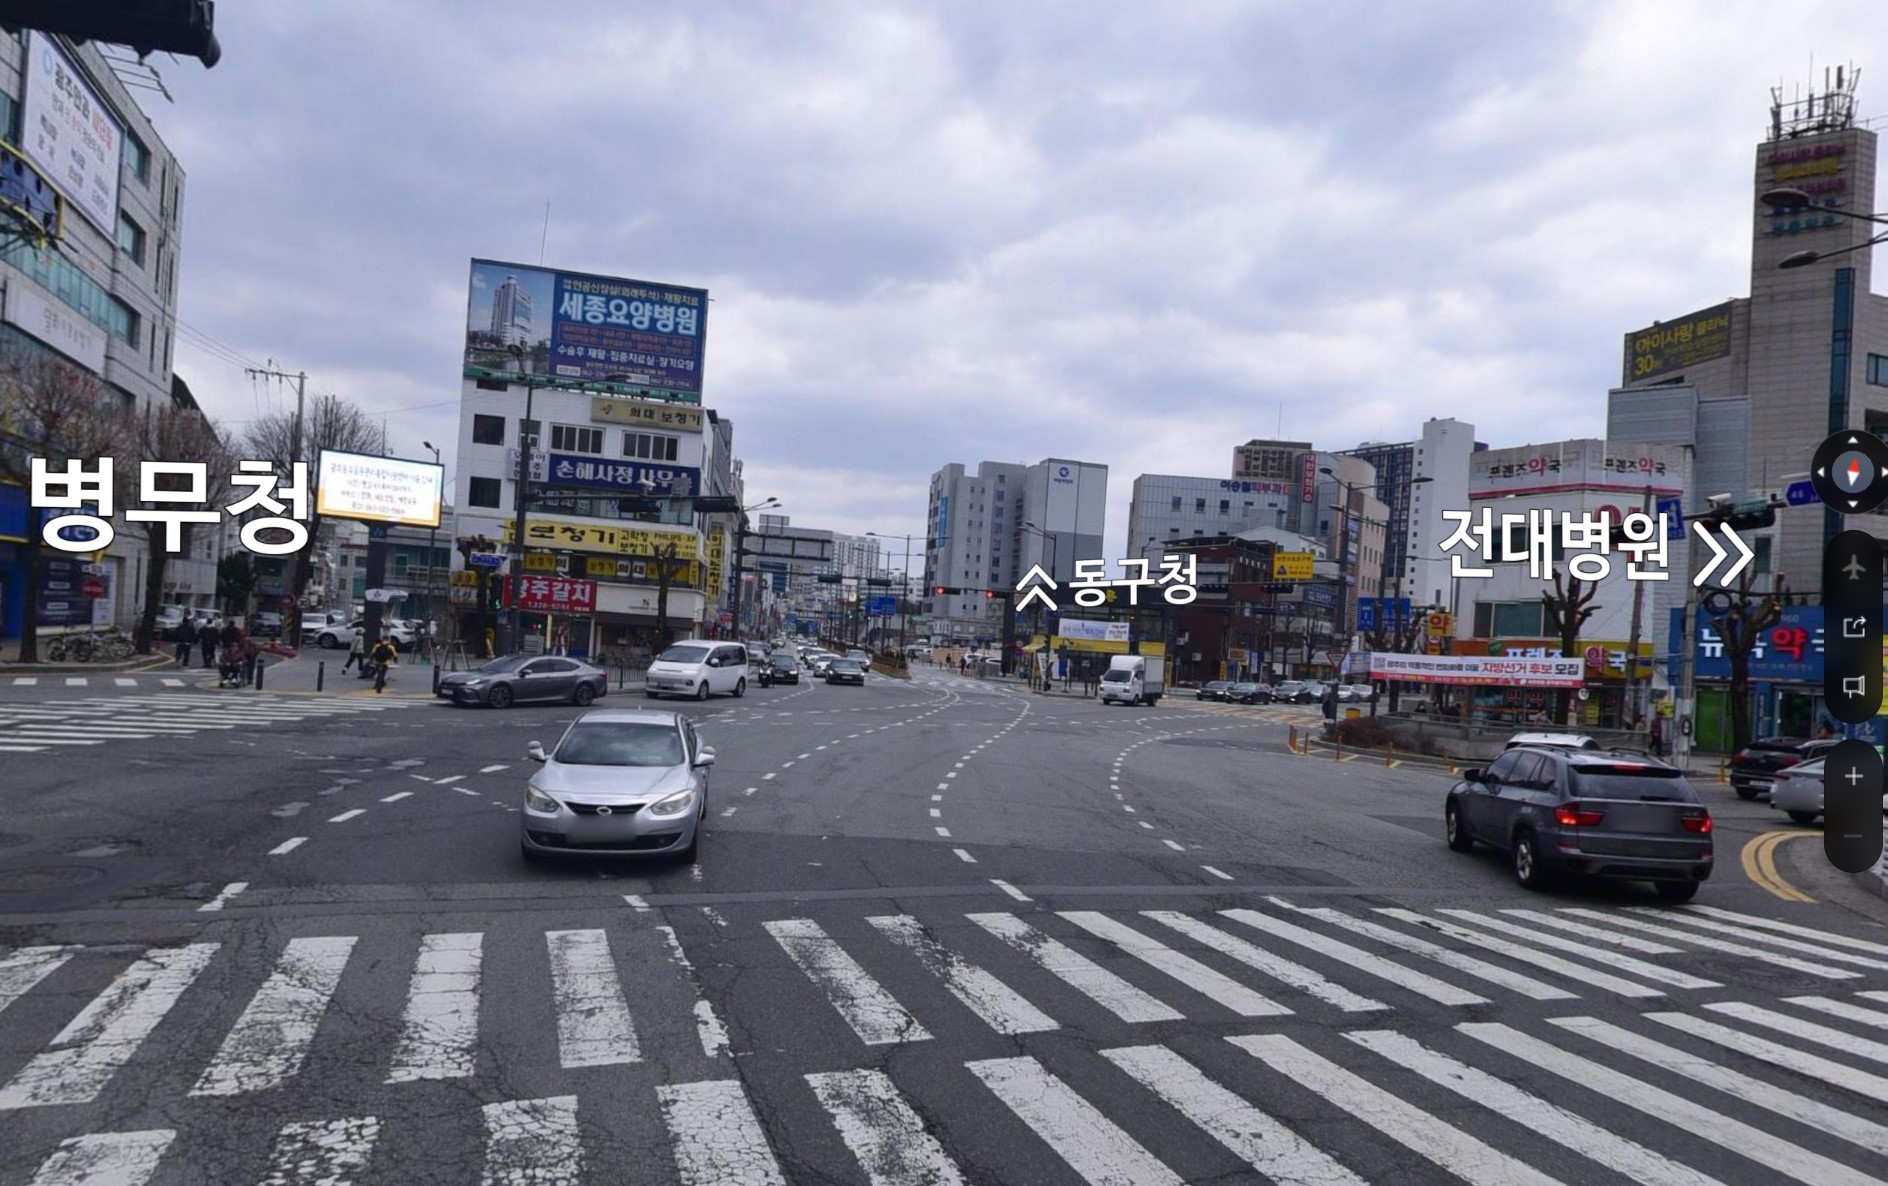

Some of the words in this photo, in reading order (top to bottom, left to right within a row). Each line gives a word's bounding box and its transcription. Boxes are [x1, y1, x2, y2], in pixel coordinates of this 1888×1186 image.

[558, 291, 698, 336] 세종요양병원
[1635, 321, 1693, 353] 아이사랑
[630, 407, 655, 420] 의대
[661, 409, 701, 425] 보청기
[556, 460, 633, 485] 손해사정
[528, 524, 616, 545] 보청기
[1429, 614, 1451, 635] 약
[1482, 661, 1527, 674] 지방선거
[1529, 663, 1553, 675] 후보
[1555, 663, 1580, 676] 모집
